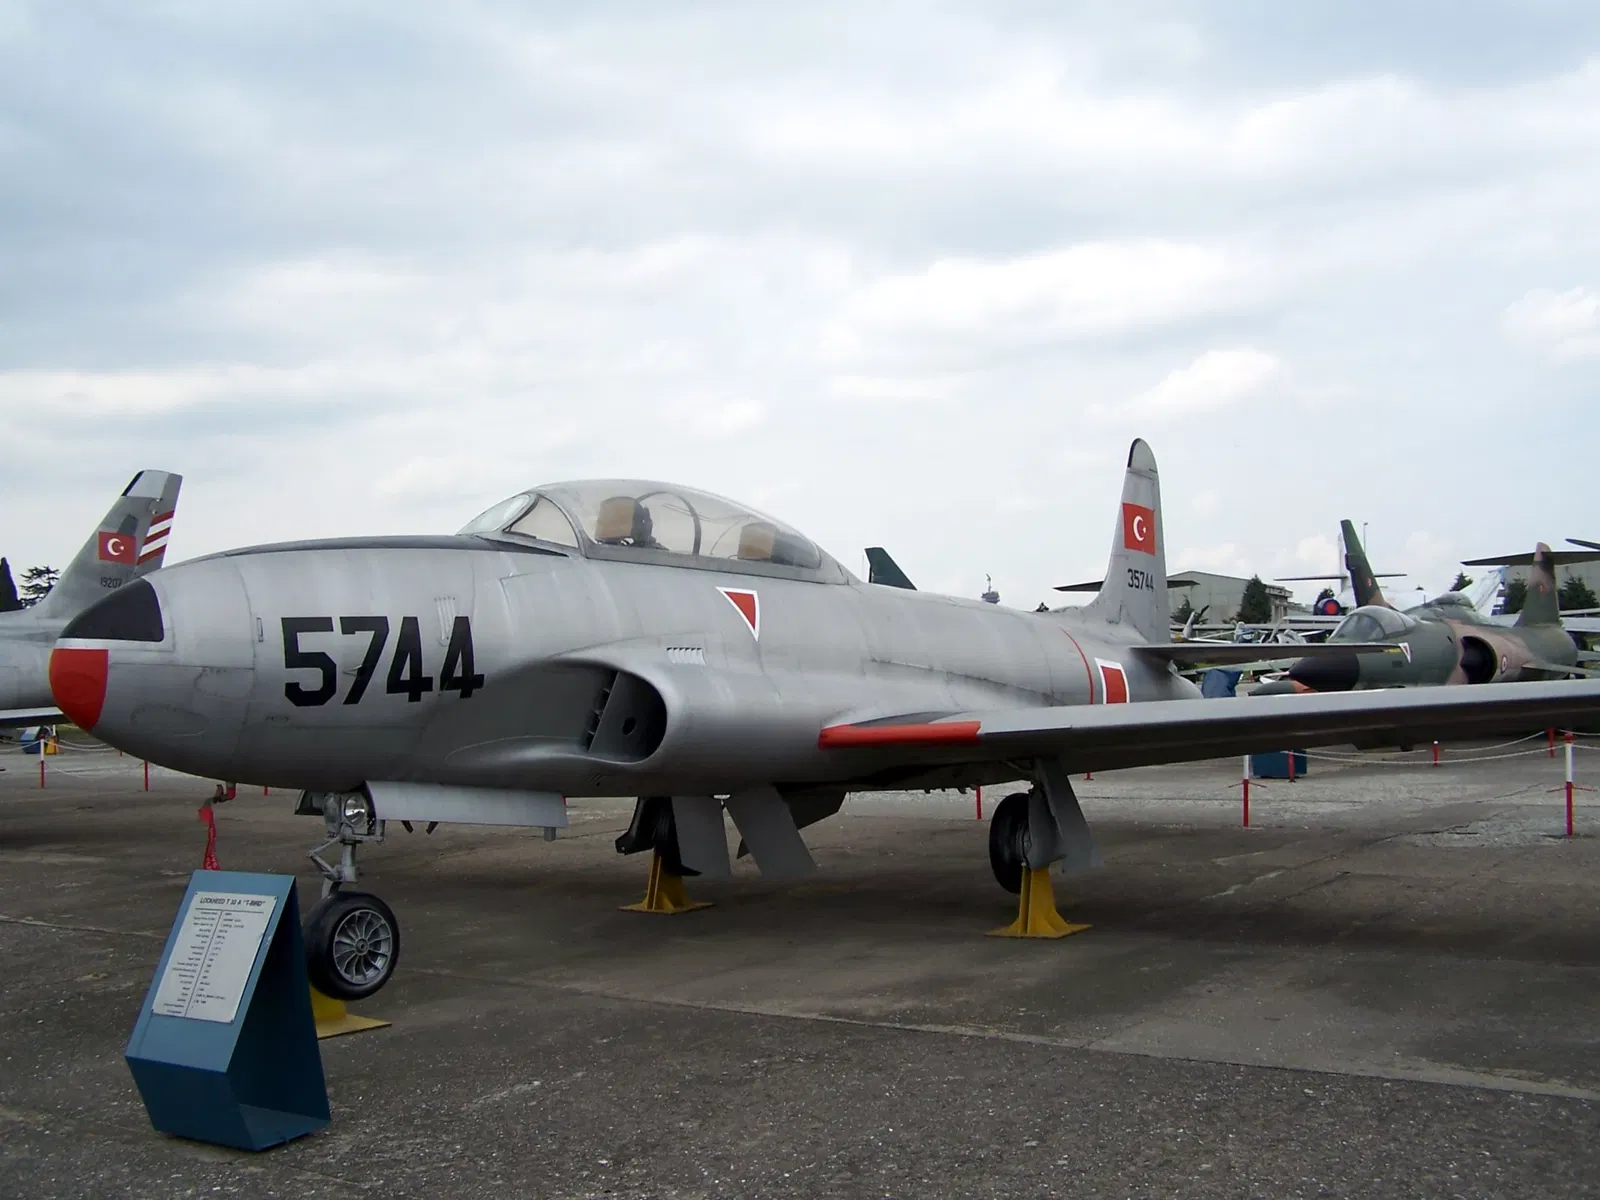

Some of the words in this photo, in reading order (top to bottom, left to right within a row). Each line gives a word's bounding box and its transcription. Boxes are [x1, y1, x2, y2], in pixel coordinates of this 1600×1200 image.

[1127, 568, 1154, 592] 35744
[281, 616, 485, 707] 5744
[200, 897, 225, 905] LOCKHEED
